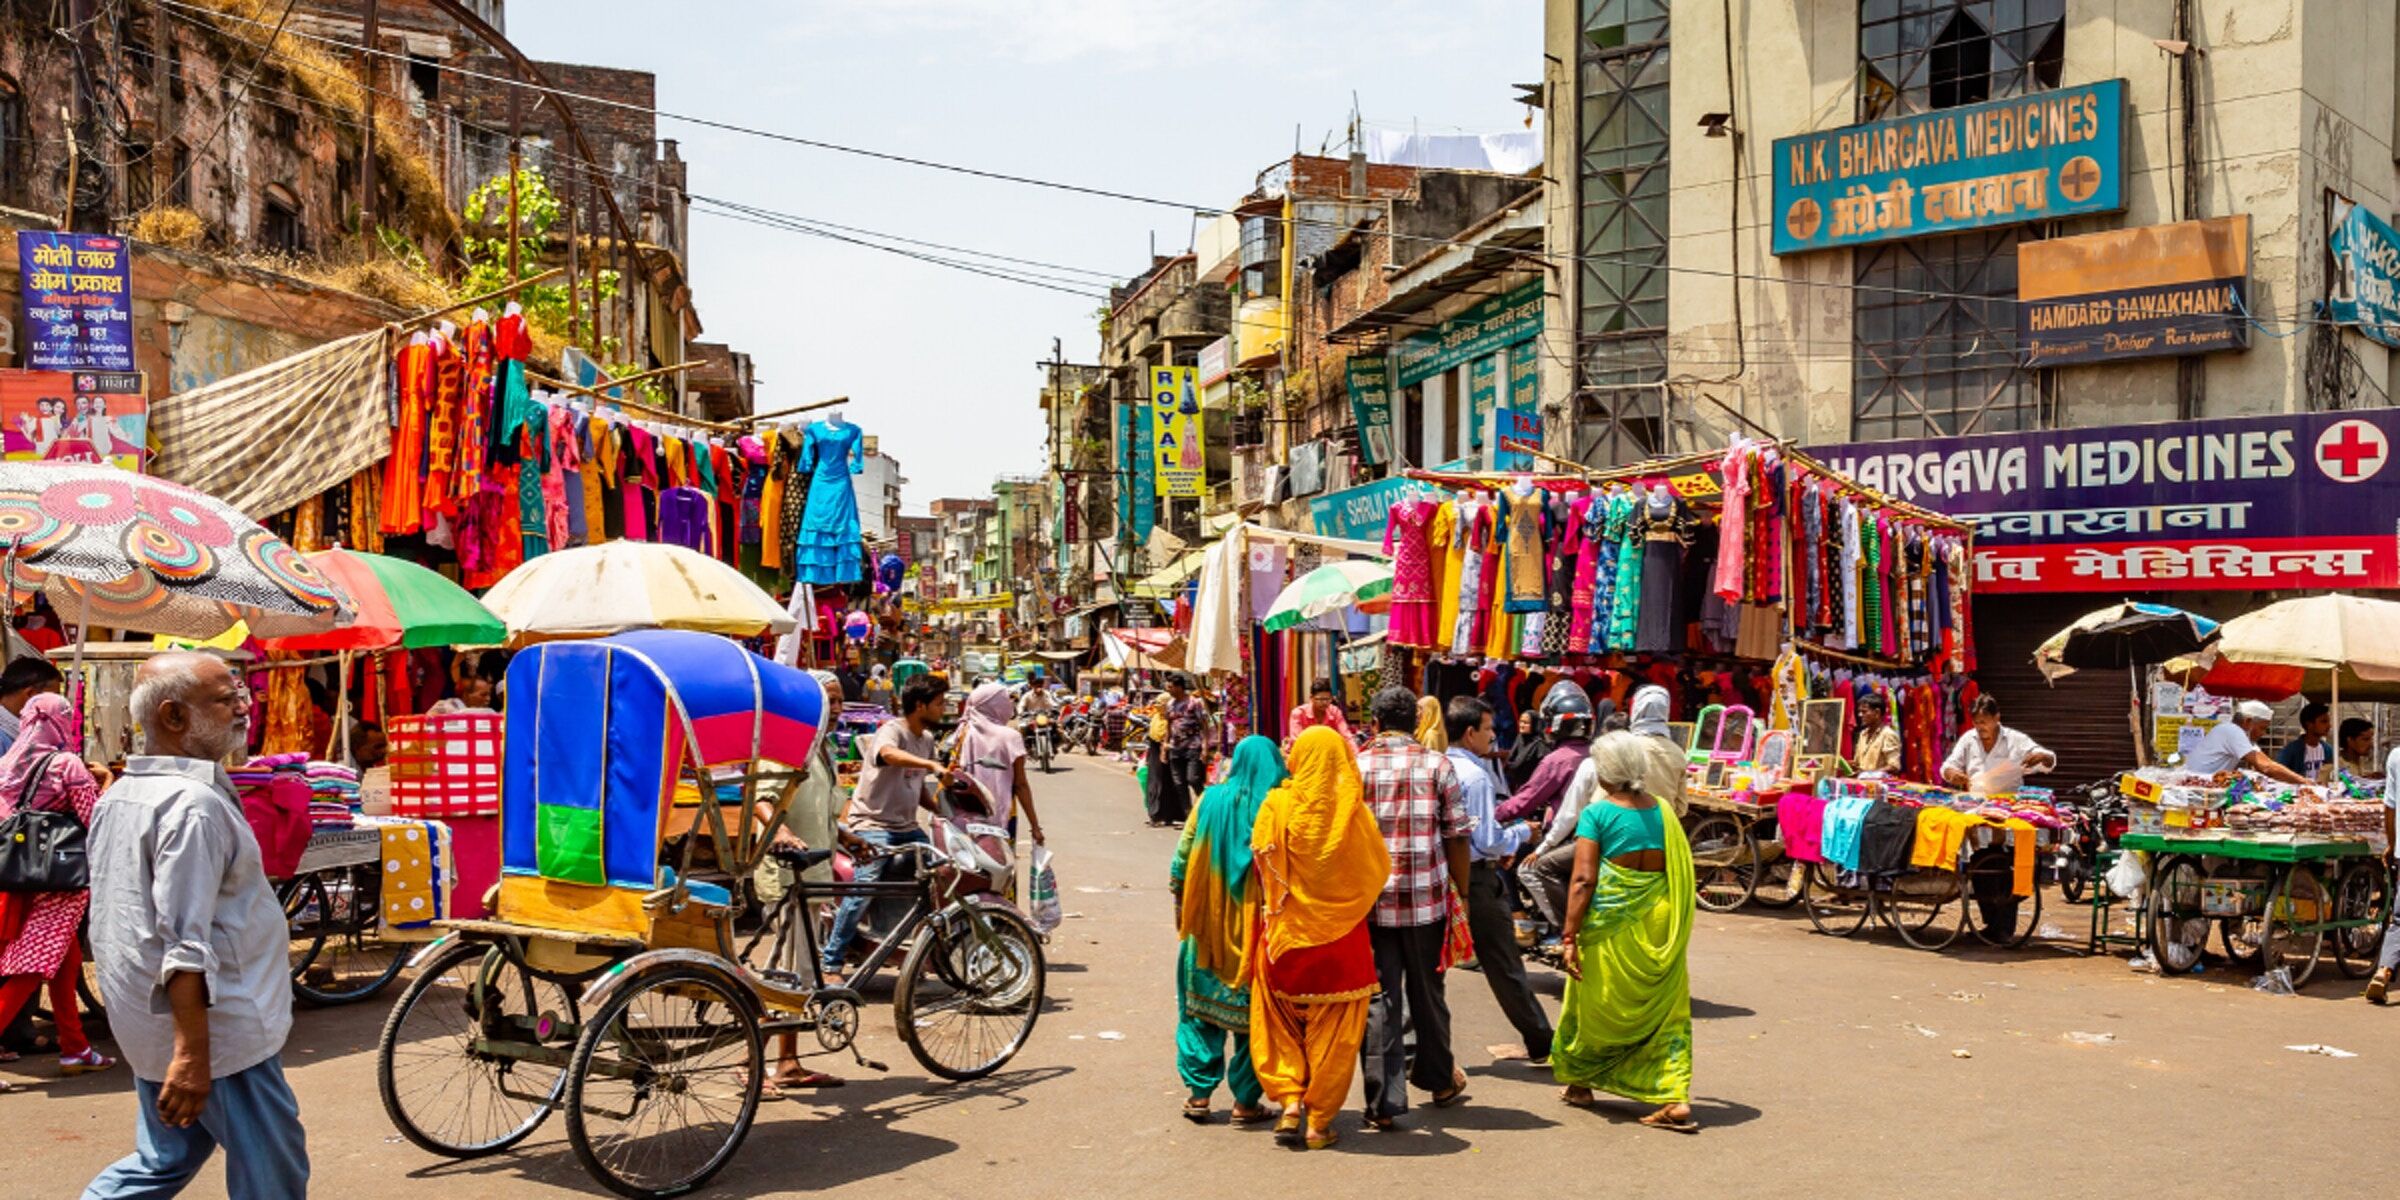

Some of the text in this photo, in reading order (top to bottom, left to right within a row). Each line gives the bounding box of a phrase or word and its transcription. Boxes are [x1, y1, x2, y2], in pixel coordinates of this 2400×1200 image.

[1791, 92, 2099, 187] N.K. BHARGAVA MEDICINES
[1922, 167, 2050, 223] दवाखाना
[29, 267, 122, 293] ओम प्रकाश
[32, 243, 72, 267] मोती
[76, 250, 116, 269] लाल
[2030, 286, 2233, 332] HAMDARD DAWAKHANA
[1156, 371, 1178, 470] ROYAL
[2043, 430, 2295, 489] MEDICINES
[2064, 545, 2374, 580] मेडिसिन्स
